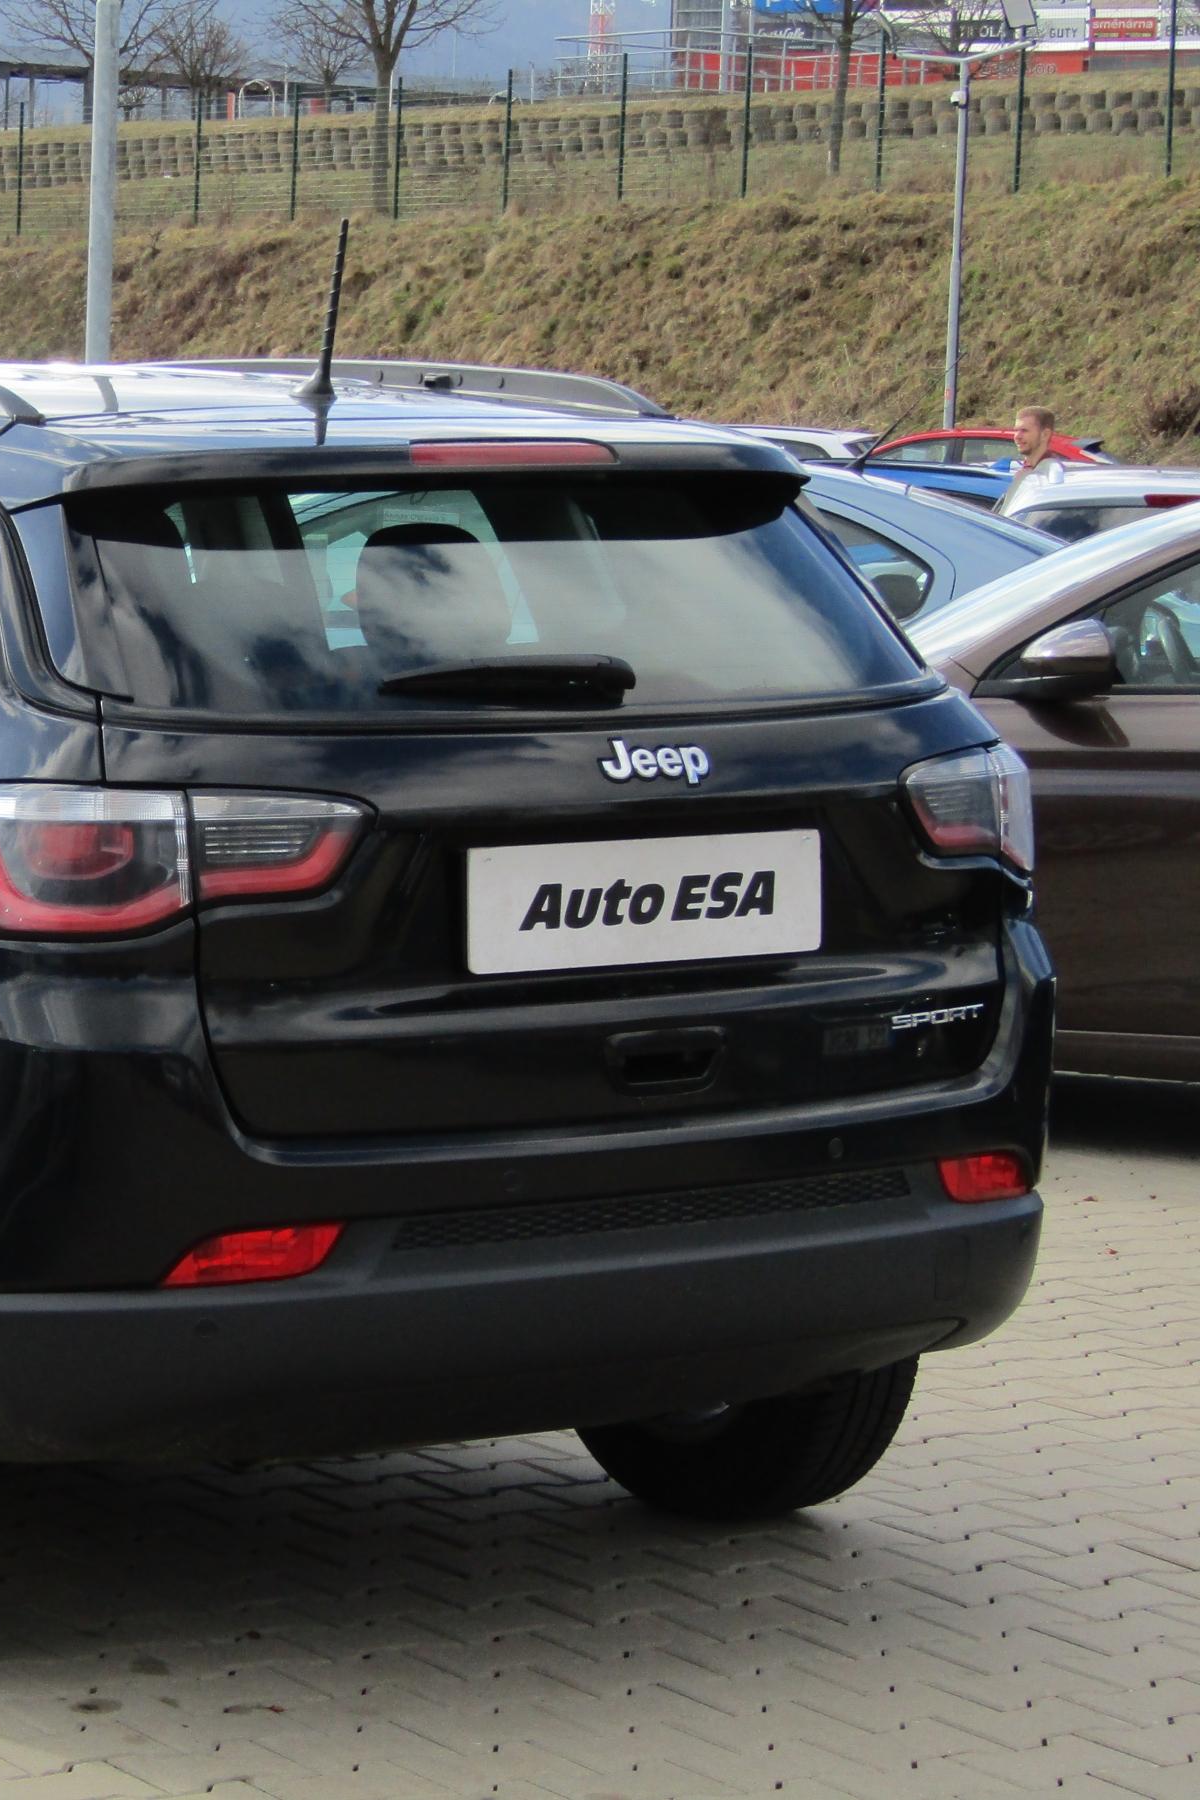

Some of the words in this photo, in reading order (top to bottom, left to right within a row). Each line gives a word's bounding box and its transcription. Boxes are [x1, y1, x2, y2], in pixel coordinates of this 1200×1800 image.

[600, 739, 709, 785] Jeep
[518, 878, 666, 932] Auto
[670, 870, 776, 922] ESA
[890, 1002, 984, 1030] SPORT
